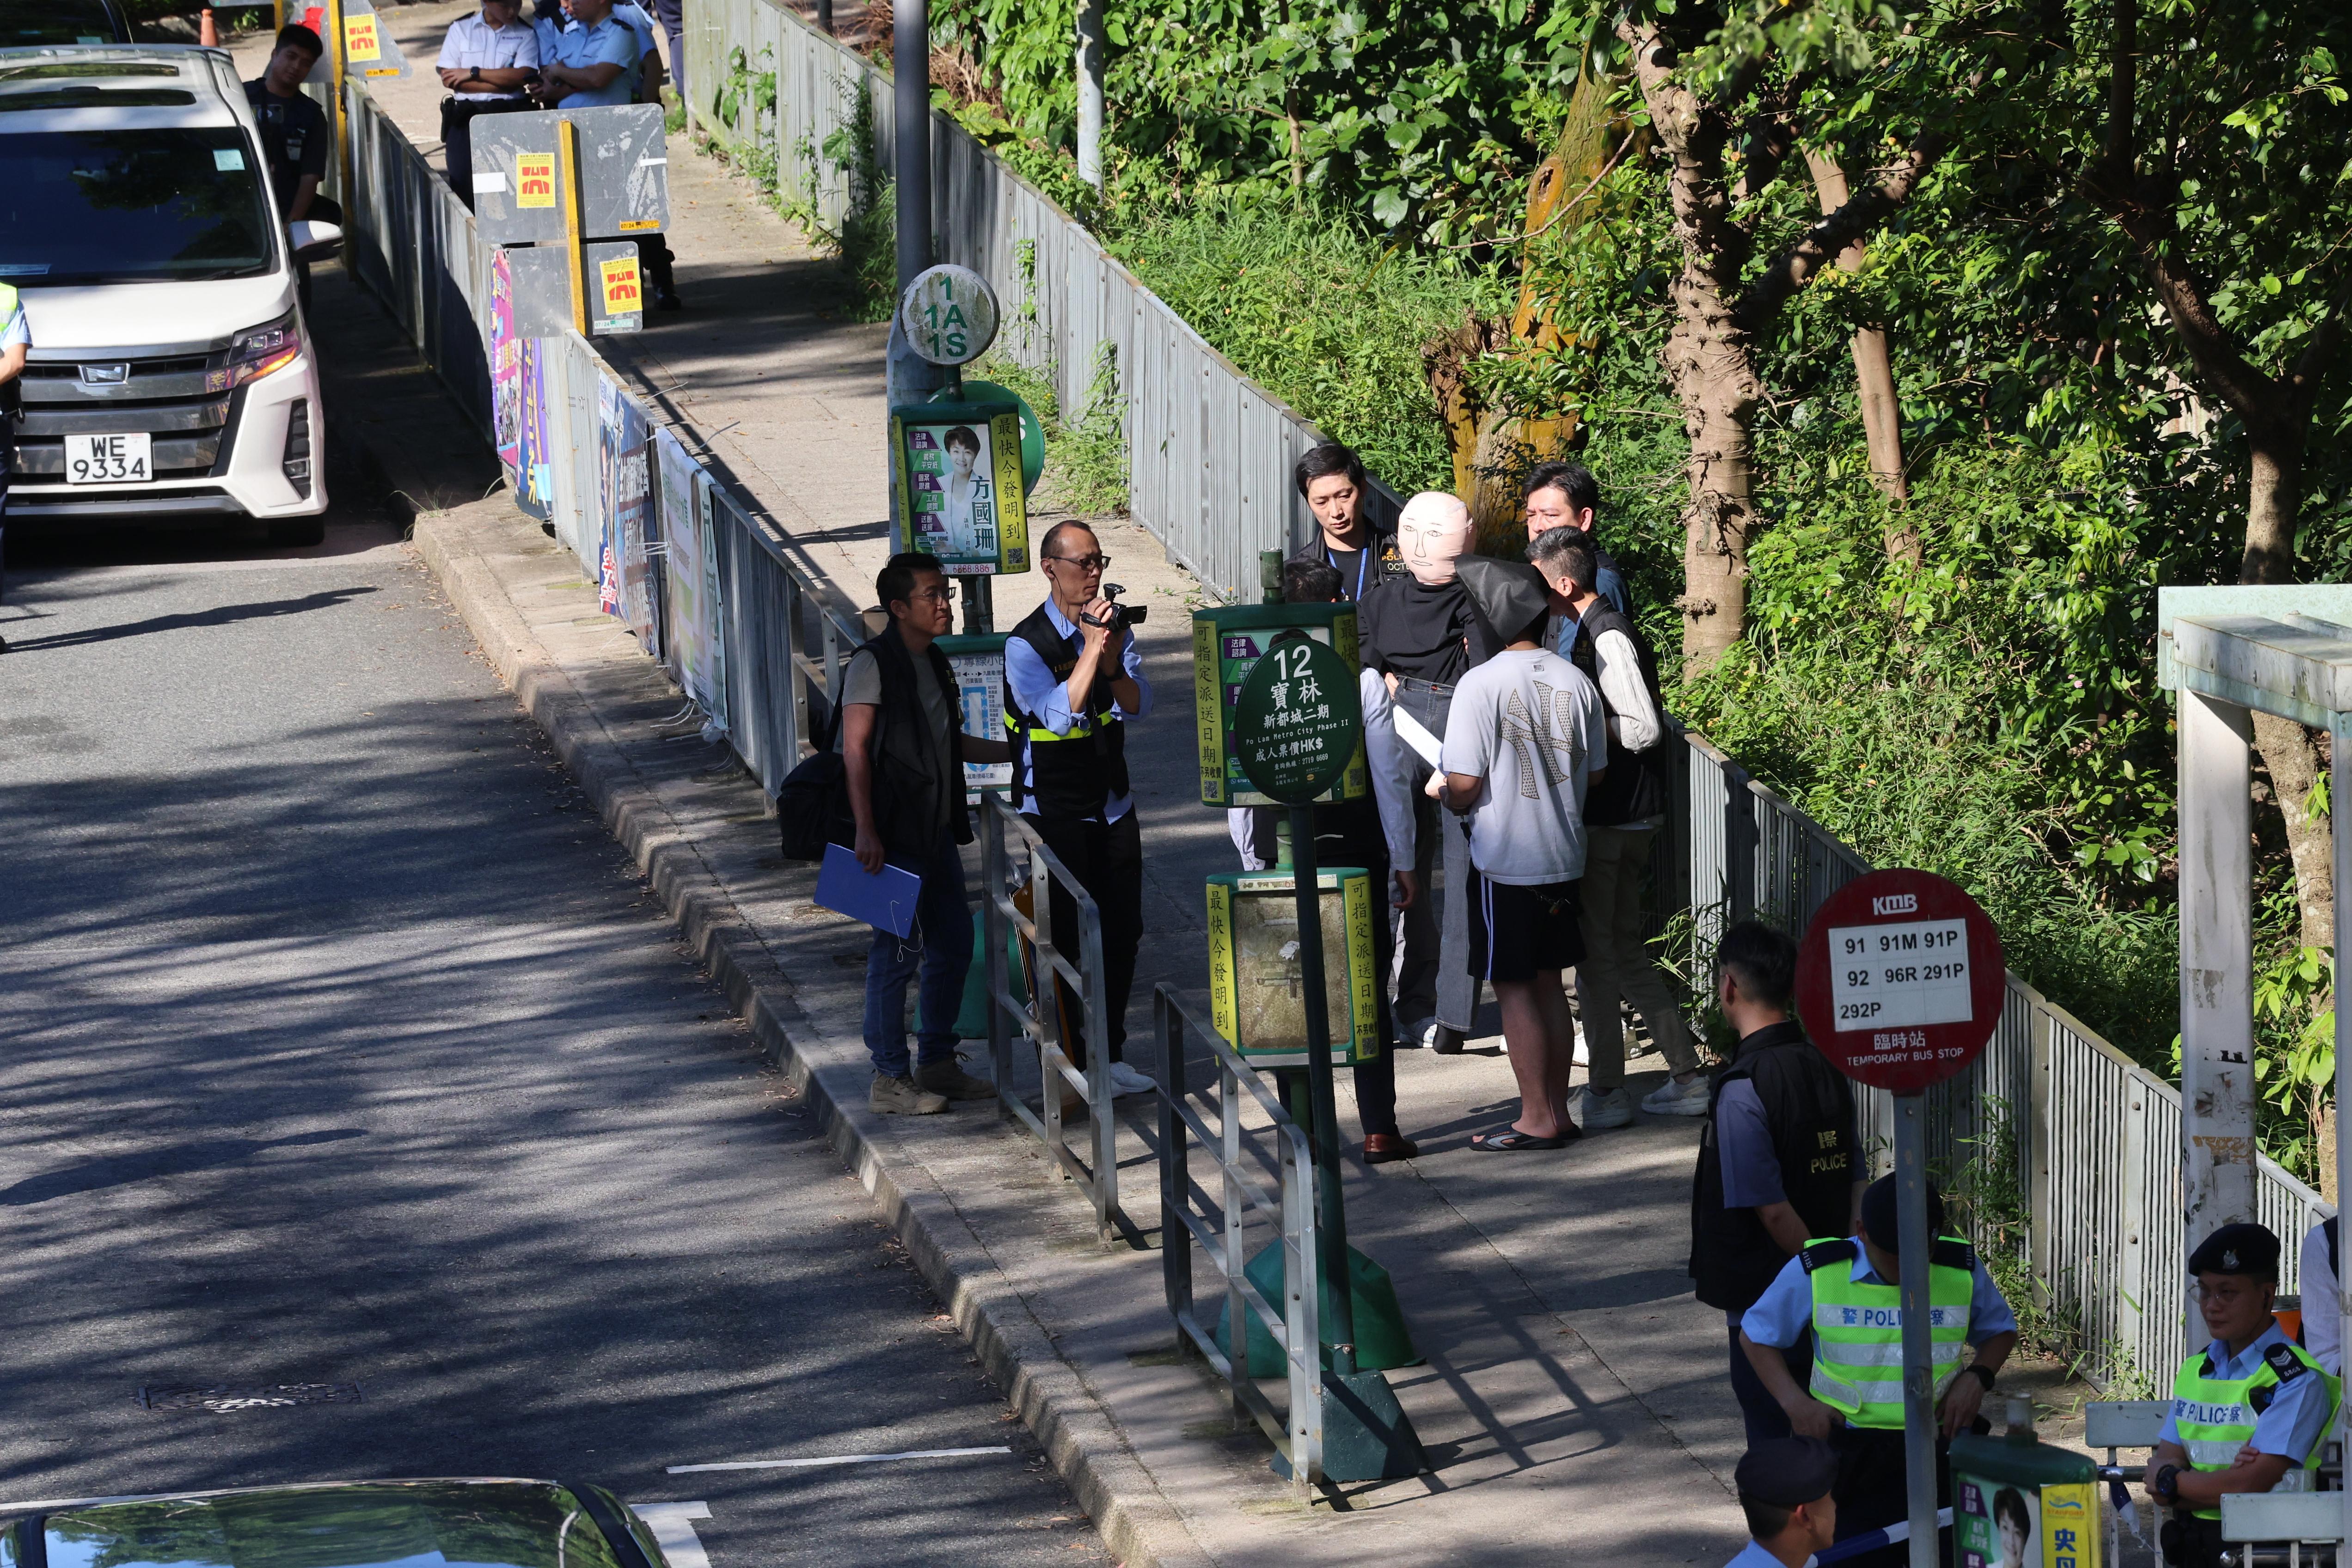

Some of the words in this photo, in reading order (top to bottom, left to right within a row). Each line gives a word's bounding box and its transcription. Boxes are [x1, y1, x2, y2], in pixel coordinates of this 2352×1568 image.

[940, 276, 952, 300] 1
[925, 304, 968, 329] 1A
[927, 332, 967, 357] 1S
[91, 436, 126, 457] WE
[73, 457, 145, 480] 9334
[998, 417, 1021, 539] 最快今發明到
[970, 476, 995, 552] 方國珊
[1231, 639, 1246, 648] 法律
[1231, 648, 1247, 657] 諮詢
[1274, 644, 1313, 680] 12
[1196, 626, 1216, 764] 可指定派送日期
[1270, 677, 1323, 712] 寶林
[1263, 704, 1329, 730] 新都城二期
[1257, 734, 1270, 743] Lam
[1273, 729, 1293, 740] Metro
[1297, 726, 1313, 737] City
[1317, 722, 1337, 732] Phase
[1316, 753, 1329, 762] 6669
[1872, 894, 1918, 916] KMB
[1351, 882, 1375, 1019] 可指定派送日期
[1844, 937, 1865, 955] 91
[1880, 932, 1917, 951] 91M
[1924, 931, 1958, 948] 91P
[1209, 890, 1228, 1030] 最快今發明到
[1847, 970, 1870, 987] 92
[1885, 967, 1917, 983] 96R
[1923, 962, 1964, 980] 291P
[1840, 1002, 1881, 1020] 292P
[1874, 1030, 1926, 1051] 臨時站
[1847, 1052, 1907, 1066] TEMPORARY
[1913, 1050, 1933, 1061] BUS
[1938, 1047, 1964, 1059] STOP
[1811, 1152, 1847, 1174] POLICE
[1802, 1251, 1813, 1268] 61135
[1842, 1307, 1858, 1325] 警
[1930, 1308, 1944, 1326] 察
[2229, 1407, 2241, 1422] 察
